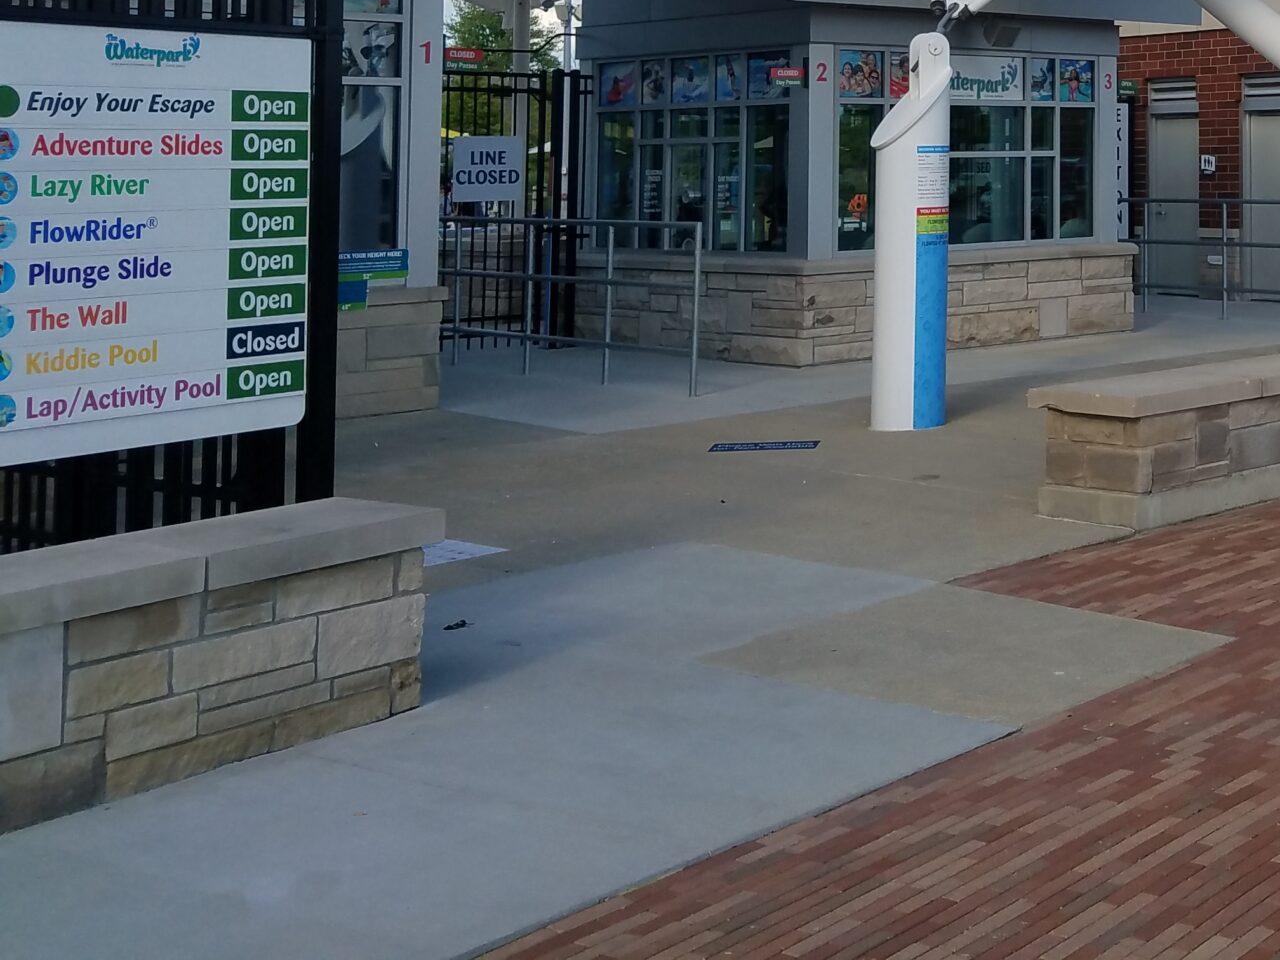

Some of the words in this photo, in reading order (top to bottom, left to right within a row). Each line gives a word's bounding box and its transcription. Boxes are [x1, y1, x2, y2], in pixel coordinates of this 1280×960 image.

[105, 38, 193, 67] Waterpark
[419, 41, 431, 64] 1
[446, 61, 458, 70] Day
[449, 50, 475, 59] CLOSED
[816, 62, 828, 82] 2
[950, 70, 1010, 100] aterpark
[1104, 73, 1112, 90] 3
[26, 91, 88, 117] Enjoy
[95, 93, 143, 113] Your
[148, 94, 215, 119] Escape
[243, 95, 296, 121] Open
[31, 133, 153, 156] Adventure
[160, 134, 223, 156] Slides
[243, 133, 296, 159] Open
[470, 150, 507, 166] LINE
[31, 174, 82, 203] Lazy
[91, 174, 149, 196] River
[242, 172, 295, 199] Open
[455, 169, 520, 185] CLOSED
[242, 211, 294, 237] Open
[28, 261, 110, 289] Plunge
[118, 255, 172, 280] Slide
[240, 252, 293, 278] Open
[26, 307, 70, 331] The
[78, 301, 128, 327] Wall
[239, 291, 292, 317] Open
[232, 327, 299, 354] Closed
[25, 347, 101, 375] Kiddie
[109, 340, 158, 367] Pool
[238, 369, 291, 396] Open
[26, 384, 167, 421] Lap/Activity
[175, 374, 221, 401] Pool
